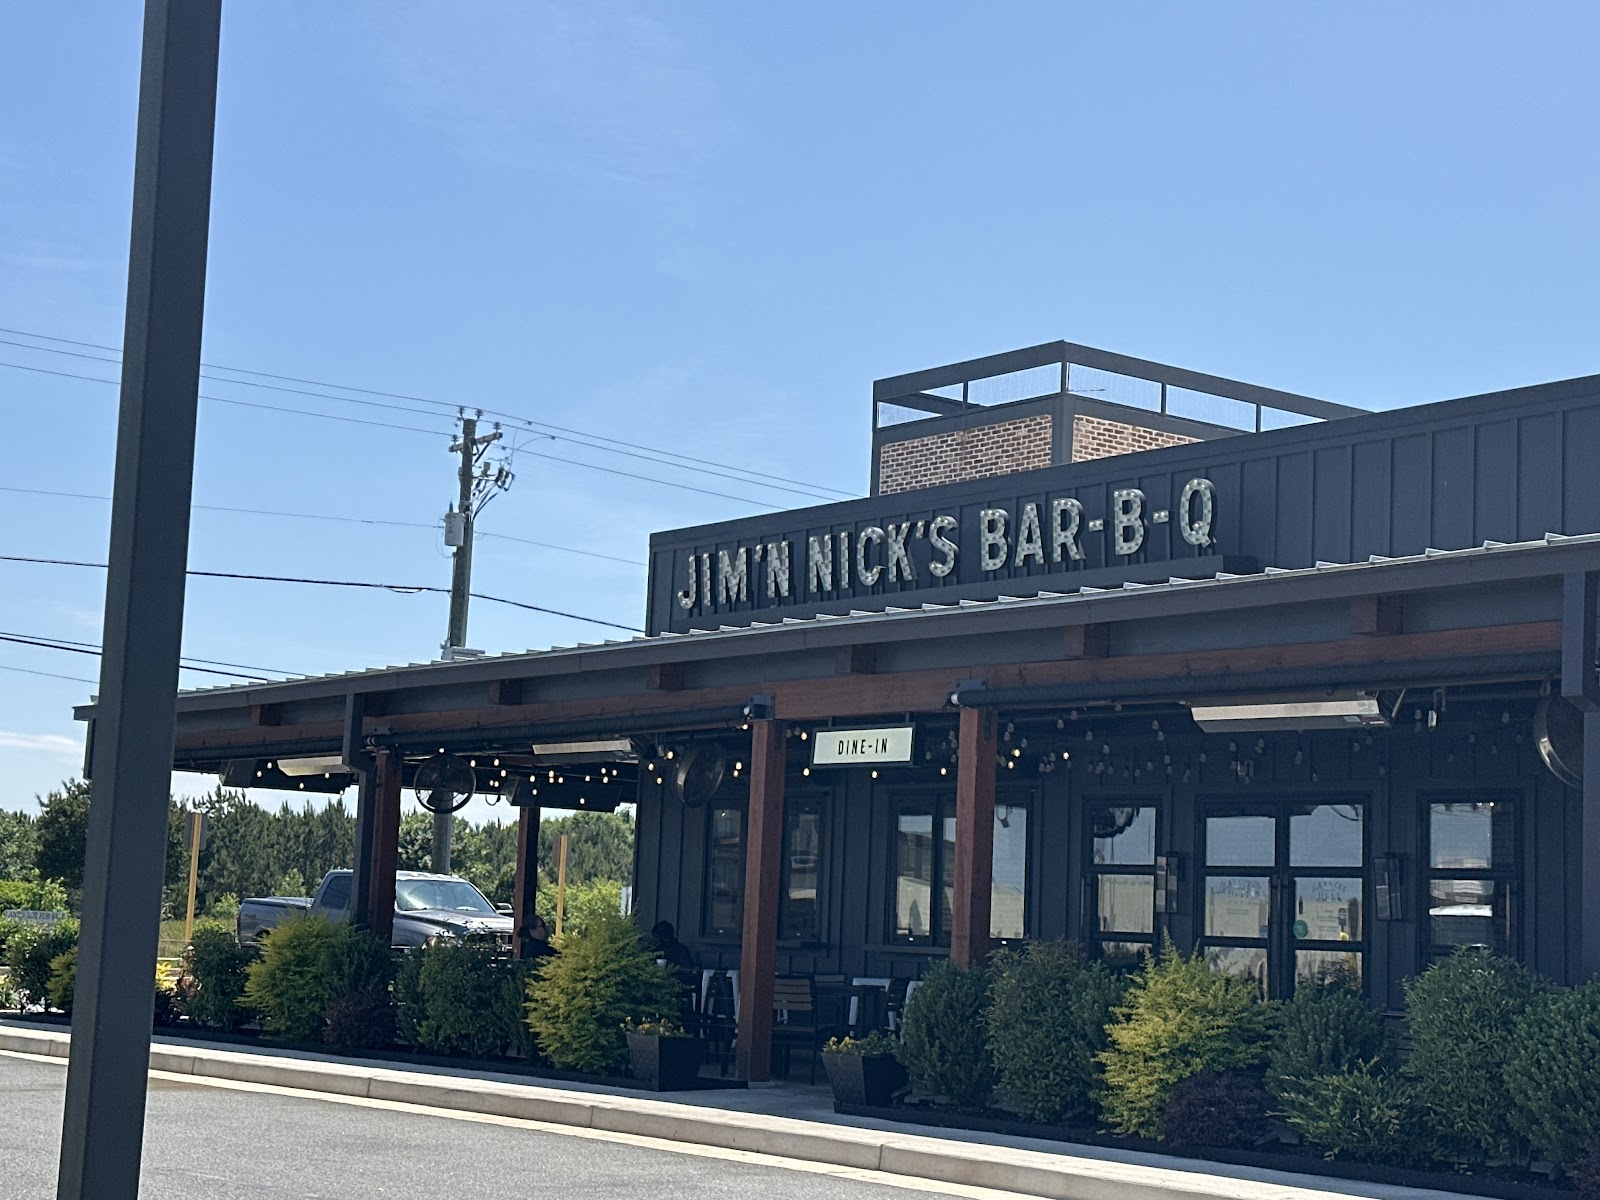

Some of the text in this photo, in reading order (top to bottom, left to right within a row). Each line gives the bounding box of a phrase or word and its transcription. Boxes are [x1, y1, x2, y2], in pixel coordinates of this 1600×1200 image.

[808, 515, 960, 593] NICK'S
[980, 477, 1217, 571] BAR-B-Q
[838, 738, 888, 755] DINE-IN
